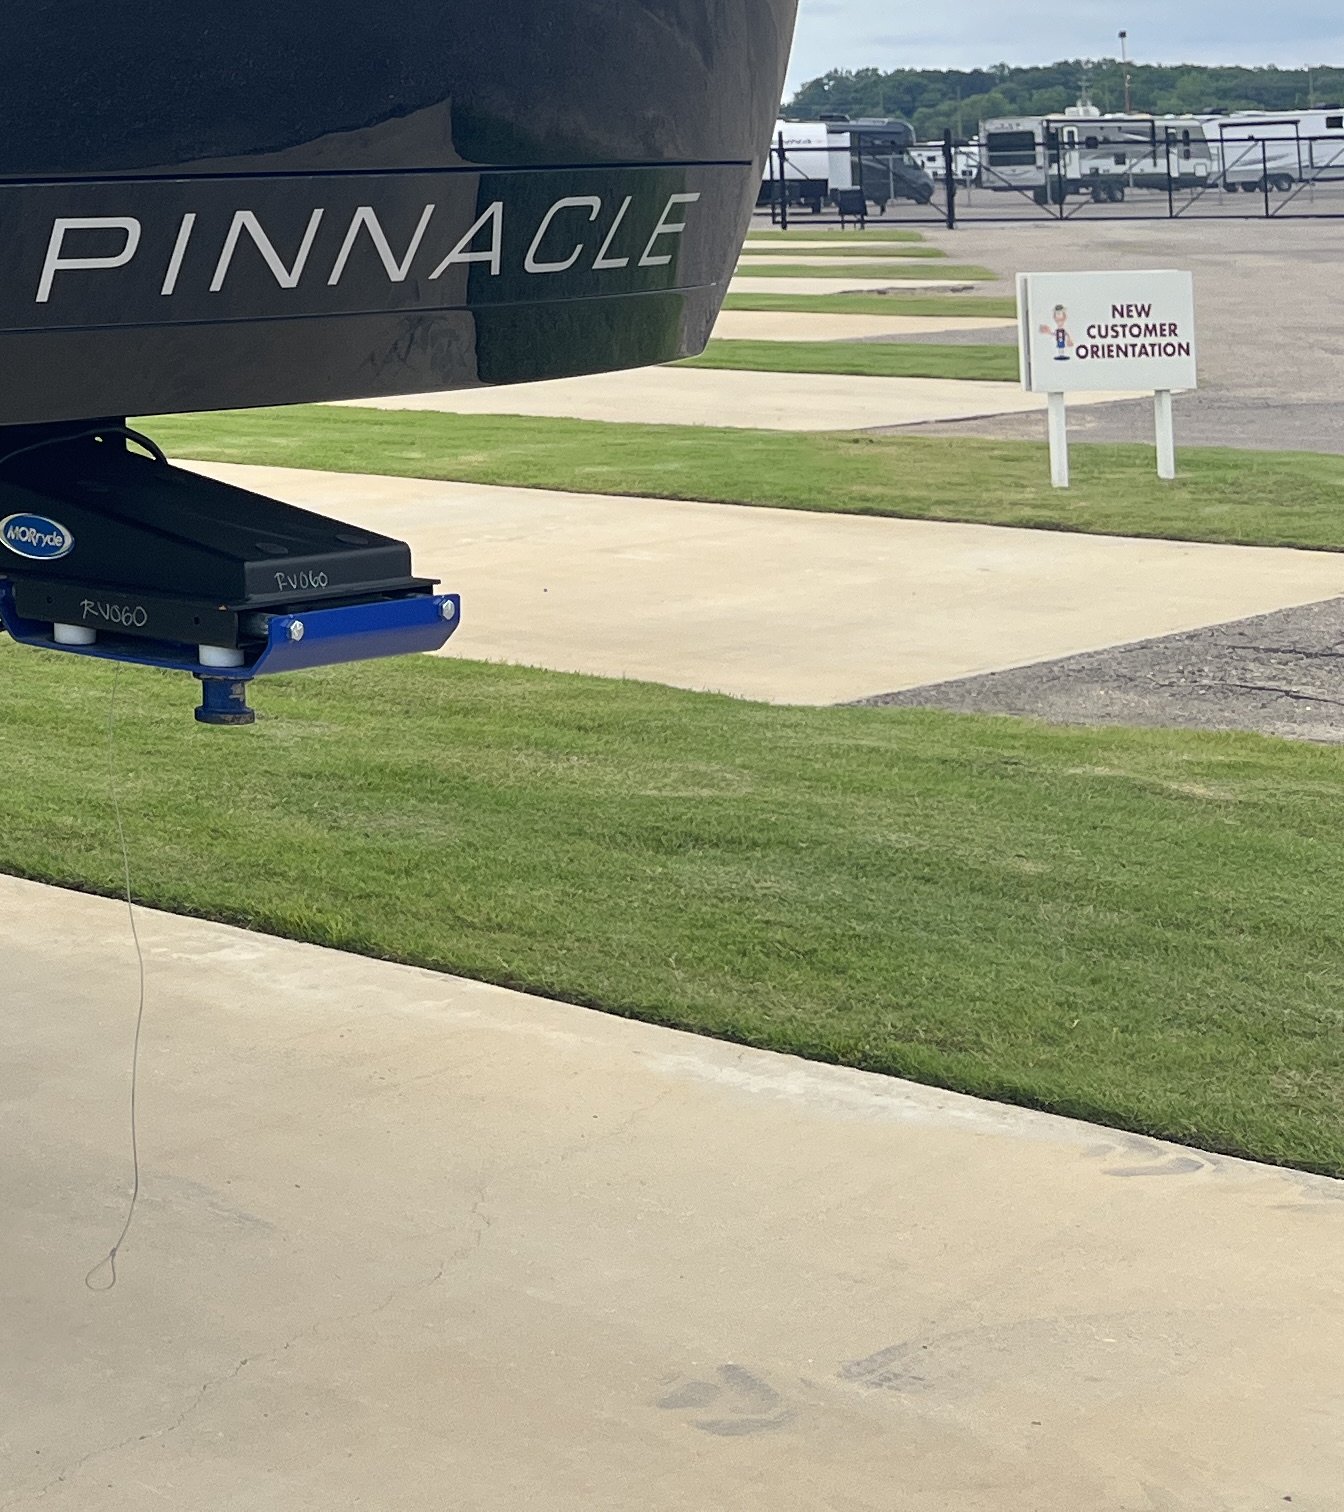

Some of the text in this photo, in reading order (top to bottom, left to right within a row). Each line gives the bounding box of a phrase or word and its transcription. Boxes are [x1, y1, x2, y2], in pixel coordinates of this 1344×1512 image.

[35, 192, 702, 304] PINNACLE
[1111, 303, 1152, 319] NEW
[1085, 322, 1179, 340] CUSTOMER
[1075, 341, 1191, 360] ORIENTATION
[5, 525, 64, 548] MORryde
